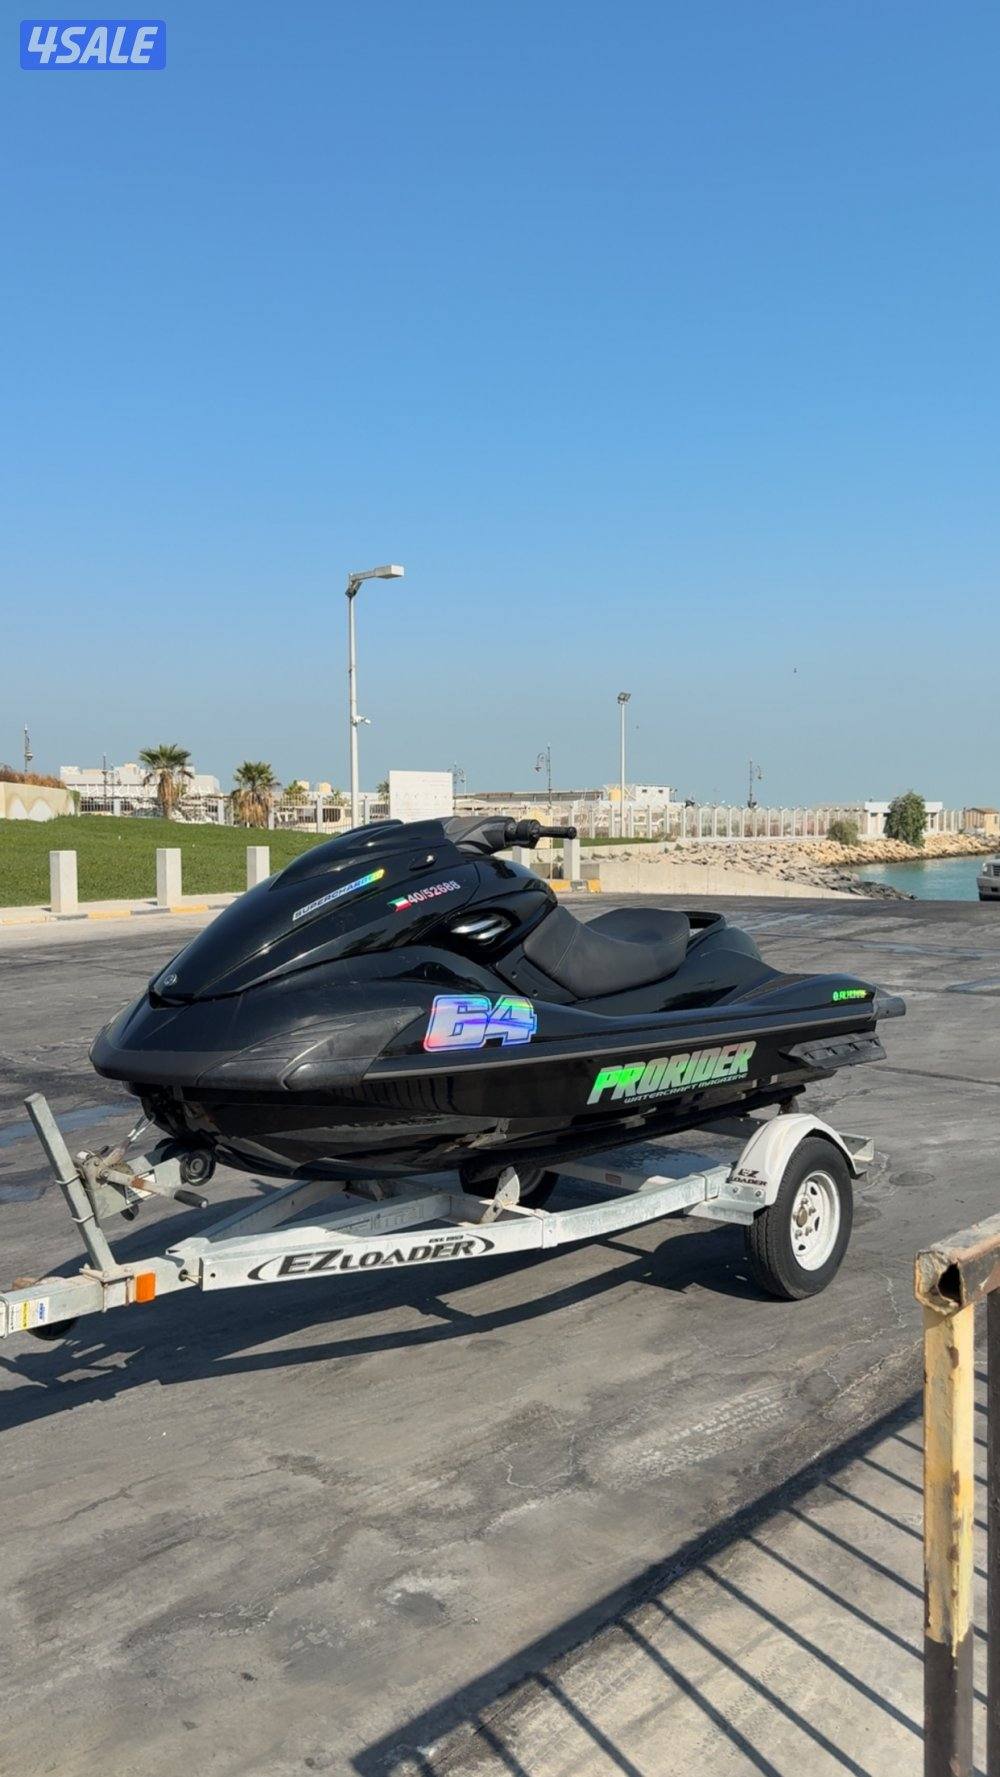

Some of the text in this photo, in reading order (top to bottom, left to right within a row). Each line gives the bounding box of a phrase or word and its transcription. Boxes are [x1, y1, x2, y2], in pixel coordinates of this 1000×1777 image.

[424, 995, 538, 1052] 64
[587, 1040, 757, 1105] PRORIDER
[624, 1072, 749, 1104] WATERCRAFT MAGAZINE
